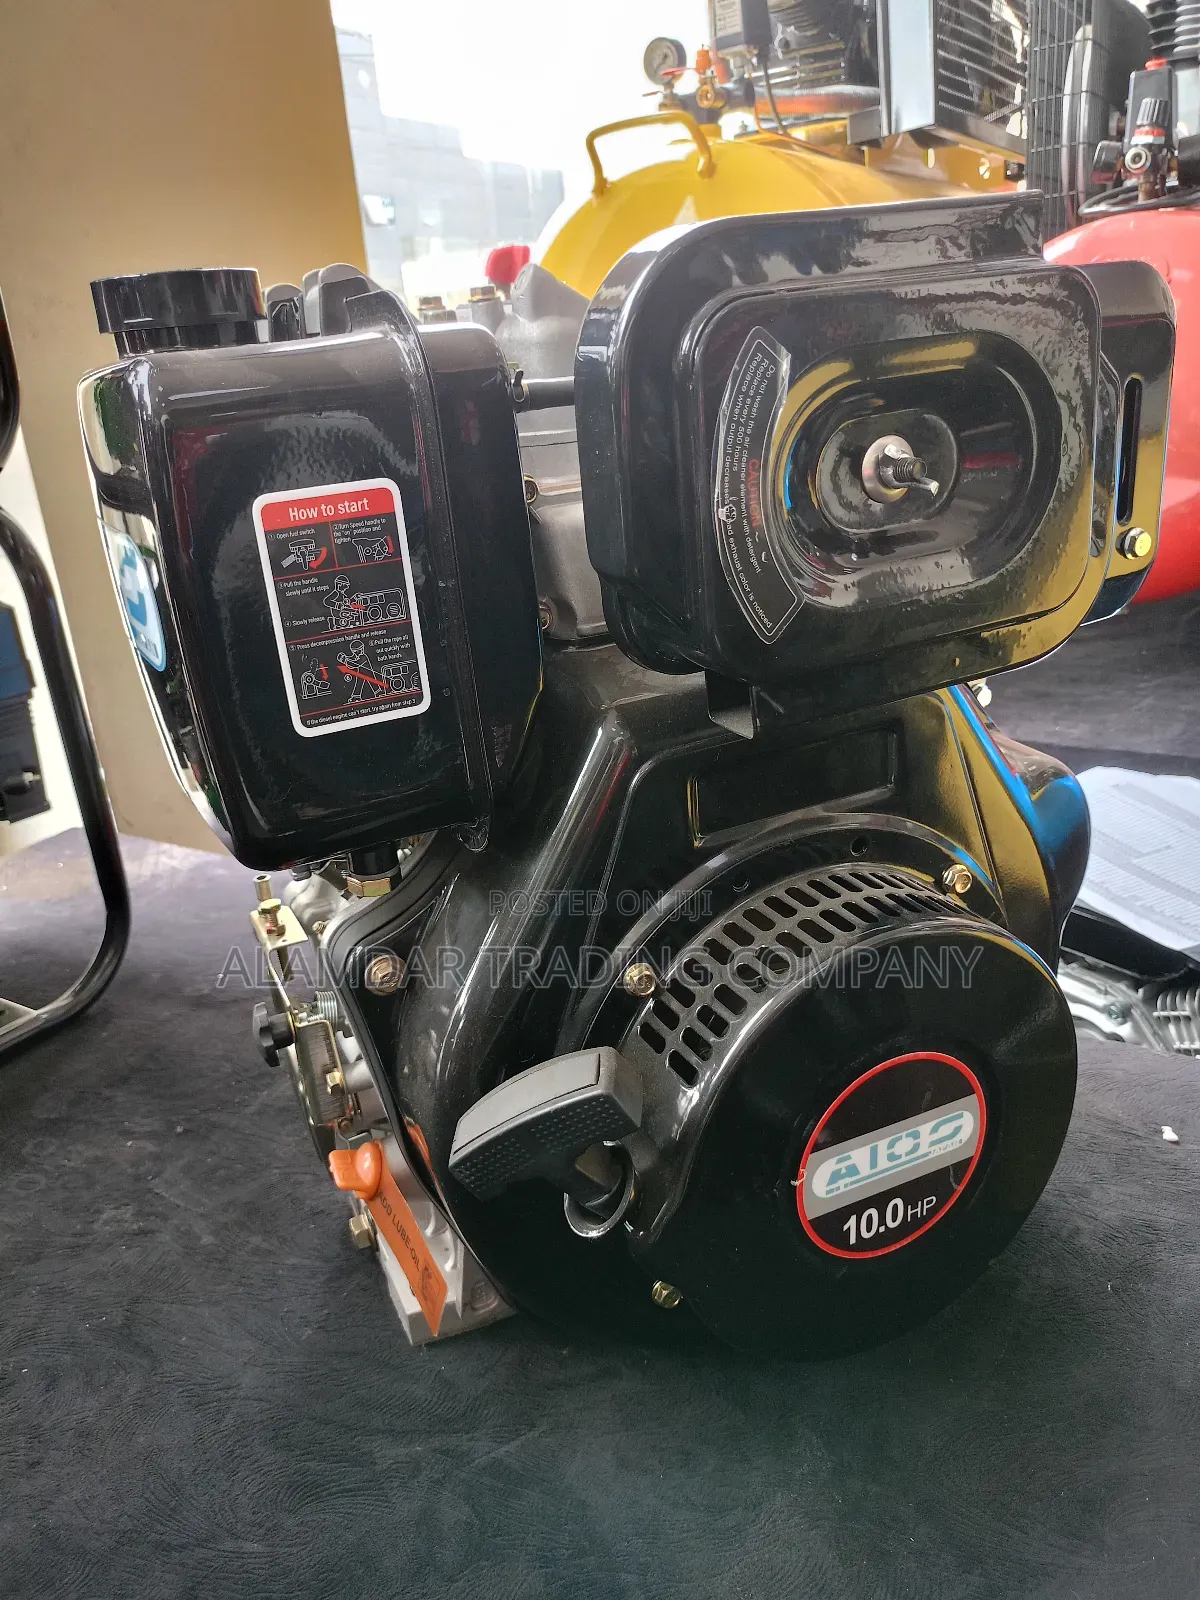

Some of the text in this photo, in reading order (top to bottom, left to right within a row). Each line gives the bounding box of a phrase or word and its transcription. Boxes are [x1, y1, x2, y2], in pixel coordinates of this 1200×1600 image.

[741, 352, 762, 393] Replace
[766, 365, 776, 378] Do
[733, 394, 744, 421] when
[733, 358, 769, 472] Replace every 500 hours
[750, 395, 762, 418] wash
[726, 423, 736, 453] output
[740, 450, 749, 482] cleaner
[724, 455, 732, 505] decreases
[740, 484, 748, 518] element
[747, 459, 760, 528] CAUTION
[288, 497, 370, 521] How to start
[353, 526, 372, 536] position
[372, 525, 382, 533] and
[365, 517, 381, 527] handle
[276, 532, 290, 541] Open
[289, 530, 299, 539] fuel
[299, 528, 316, 537] switch
[728, 537, 743, 572] exhaust
[285, 588, 301, 597] slowly
[301, 586, 312, 595] until
[294, 579, 302, 587] the
[302, 577, 319, 586] handle
[739, 572, 752, 592] color
[748, 592, 755, 601] is
[292, 618, 308, 627] Slowly
[308, 616, 326, 624] release
[752, 601, 773, 629] noticed
[297, 643, 311, 651] Press
[345, 633, 361, 643] handle
[361, 631, 370, 639] and
[400, 642, 411, 650] with
[319, 715, 333, 724] diesel
[332, 712, 348, 722] engine
[825, 1111, 965, 1187] AIOS
[377, 1191, 421, 1272] ADD LUBE-OIL
[843, 1196, 937, 1245] 10.0 HP
